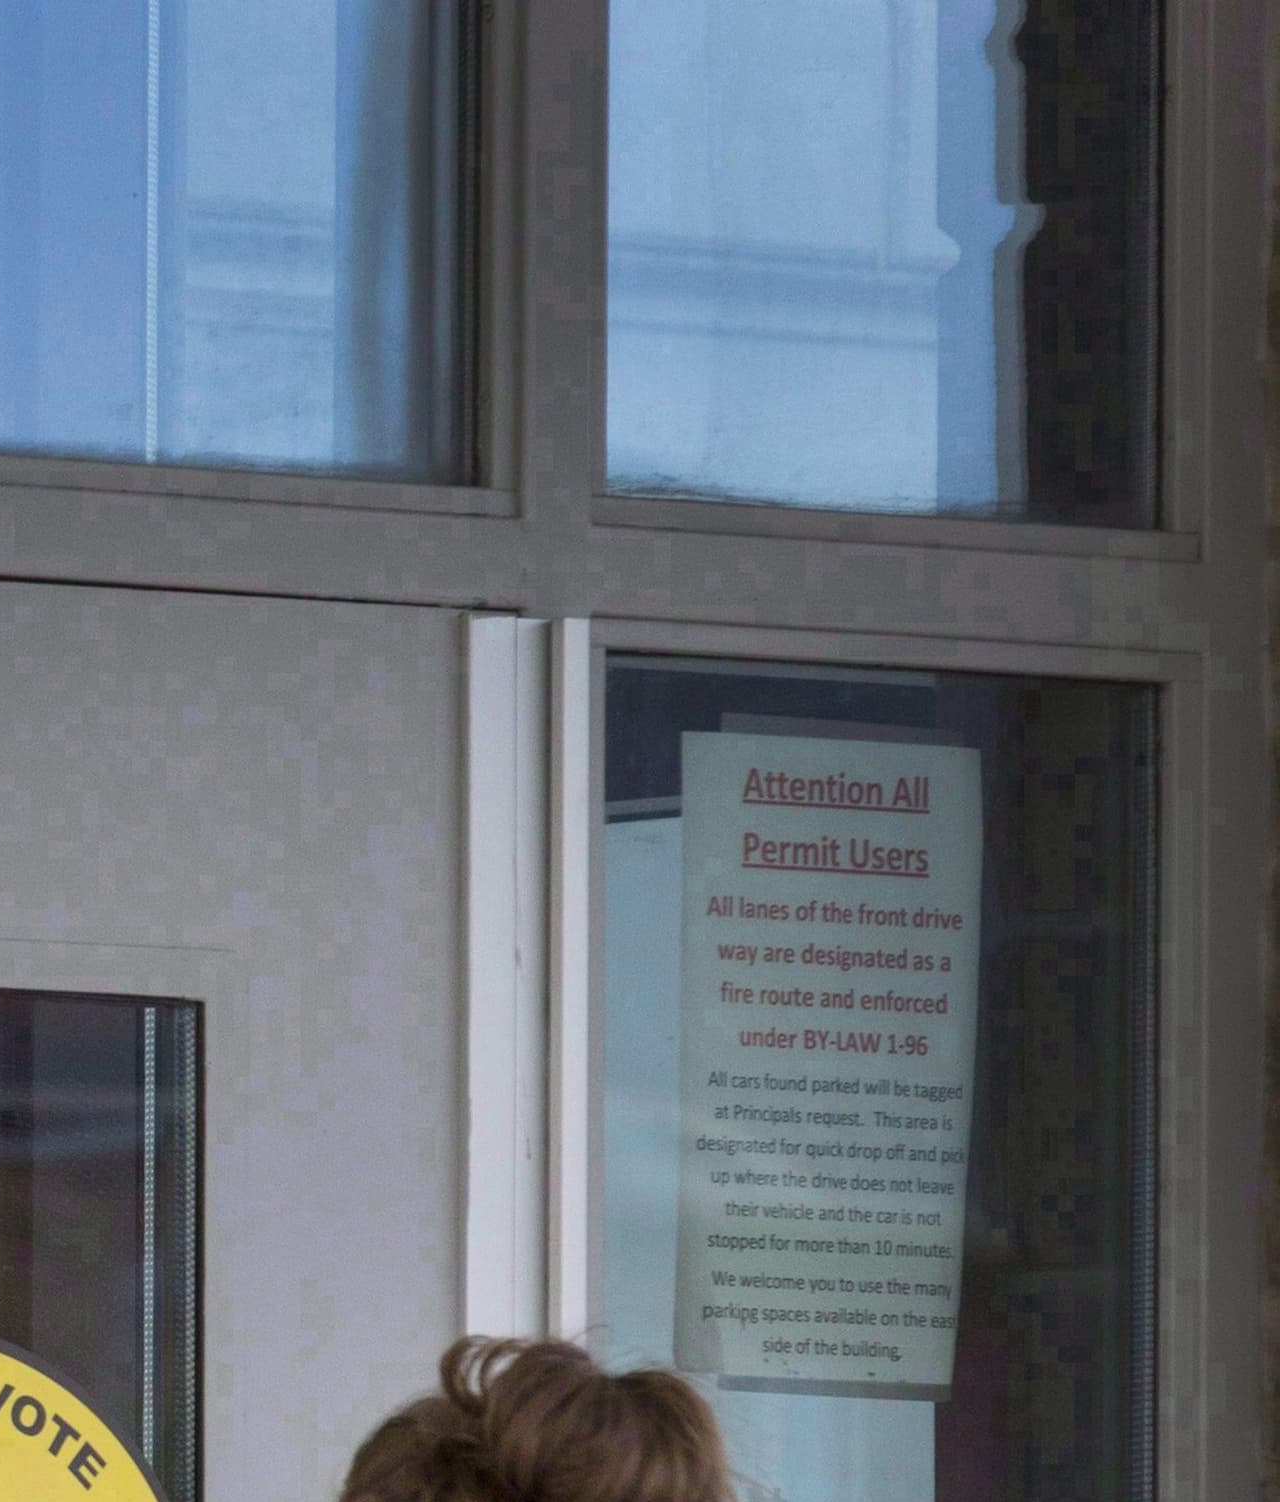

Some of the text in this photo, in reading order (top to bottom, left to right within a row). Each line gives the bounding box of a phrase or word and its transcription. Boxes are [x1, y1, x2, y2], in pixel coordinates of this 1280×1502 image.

[743, 768, 929, 809] Attention All
[743, 832, 929, 873] Permit Users
[707, 896, 963, 930] All lanes of the front drive
[718, 943, 952, 972] way are designated as a
[720, 981, 949, 1014] fire route and enforced
[739, 1027, 929, 1056] under BY-LAW 1-96
[707, 1071, 963, 1102] All cars found parked will be tagged
[714, 1104, 953, 1131] at Principals request. This area is
[696, 1134, 776, 1156] designated
[780, 1138, 801, 1155] for
[806, 1141, 844, 1159] quick
[847, 1142, 882, 1162] drop
[886, 1144, 905, 1160] off
[909, 1146, 937, 1161] and
[711, 1169, 955, 1195] up where the drive does not leave
[725, 1201, 942, 1226] their vehicle and the car is not
[707, 1234, 766, 1253] stopped
[770, 1234, 791, 1251] for
[795, 1239, 835, 1253] more
[838, 1238, 870, 1254] than
[875, 1240, 893, 1256] 10
[711, 1270, 952, 1299] We welcome you to use the many
[762, 1308, 811, 1324] spaces
[815, 1308, 877, 1325] available
[881, 1313, 899, 1326] on
[903, 1310, 927, 1328] the
[762, 1338, 792, 1353] side
[795, 1338, 811, 1354] of
[815, 1339, 838, 1355] the
